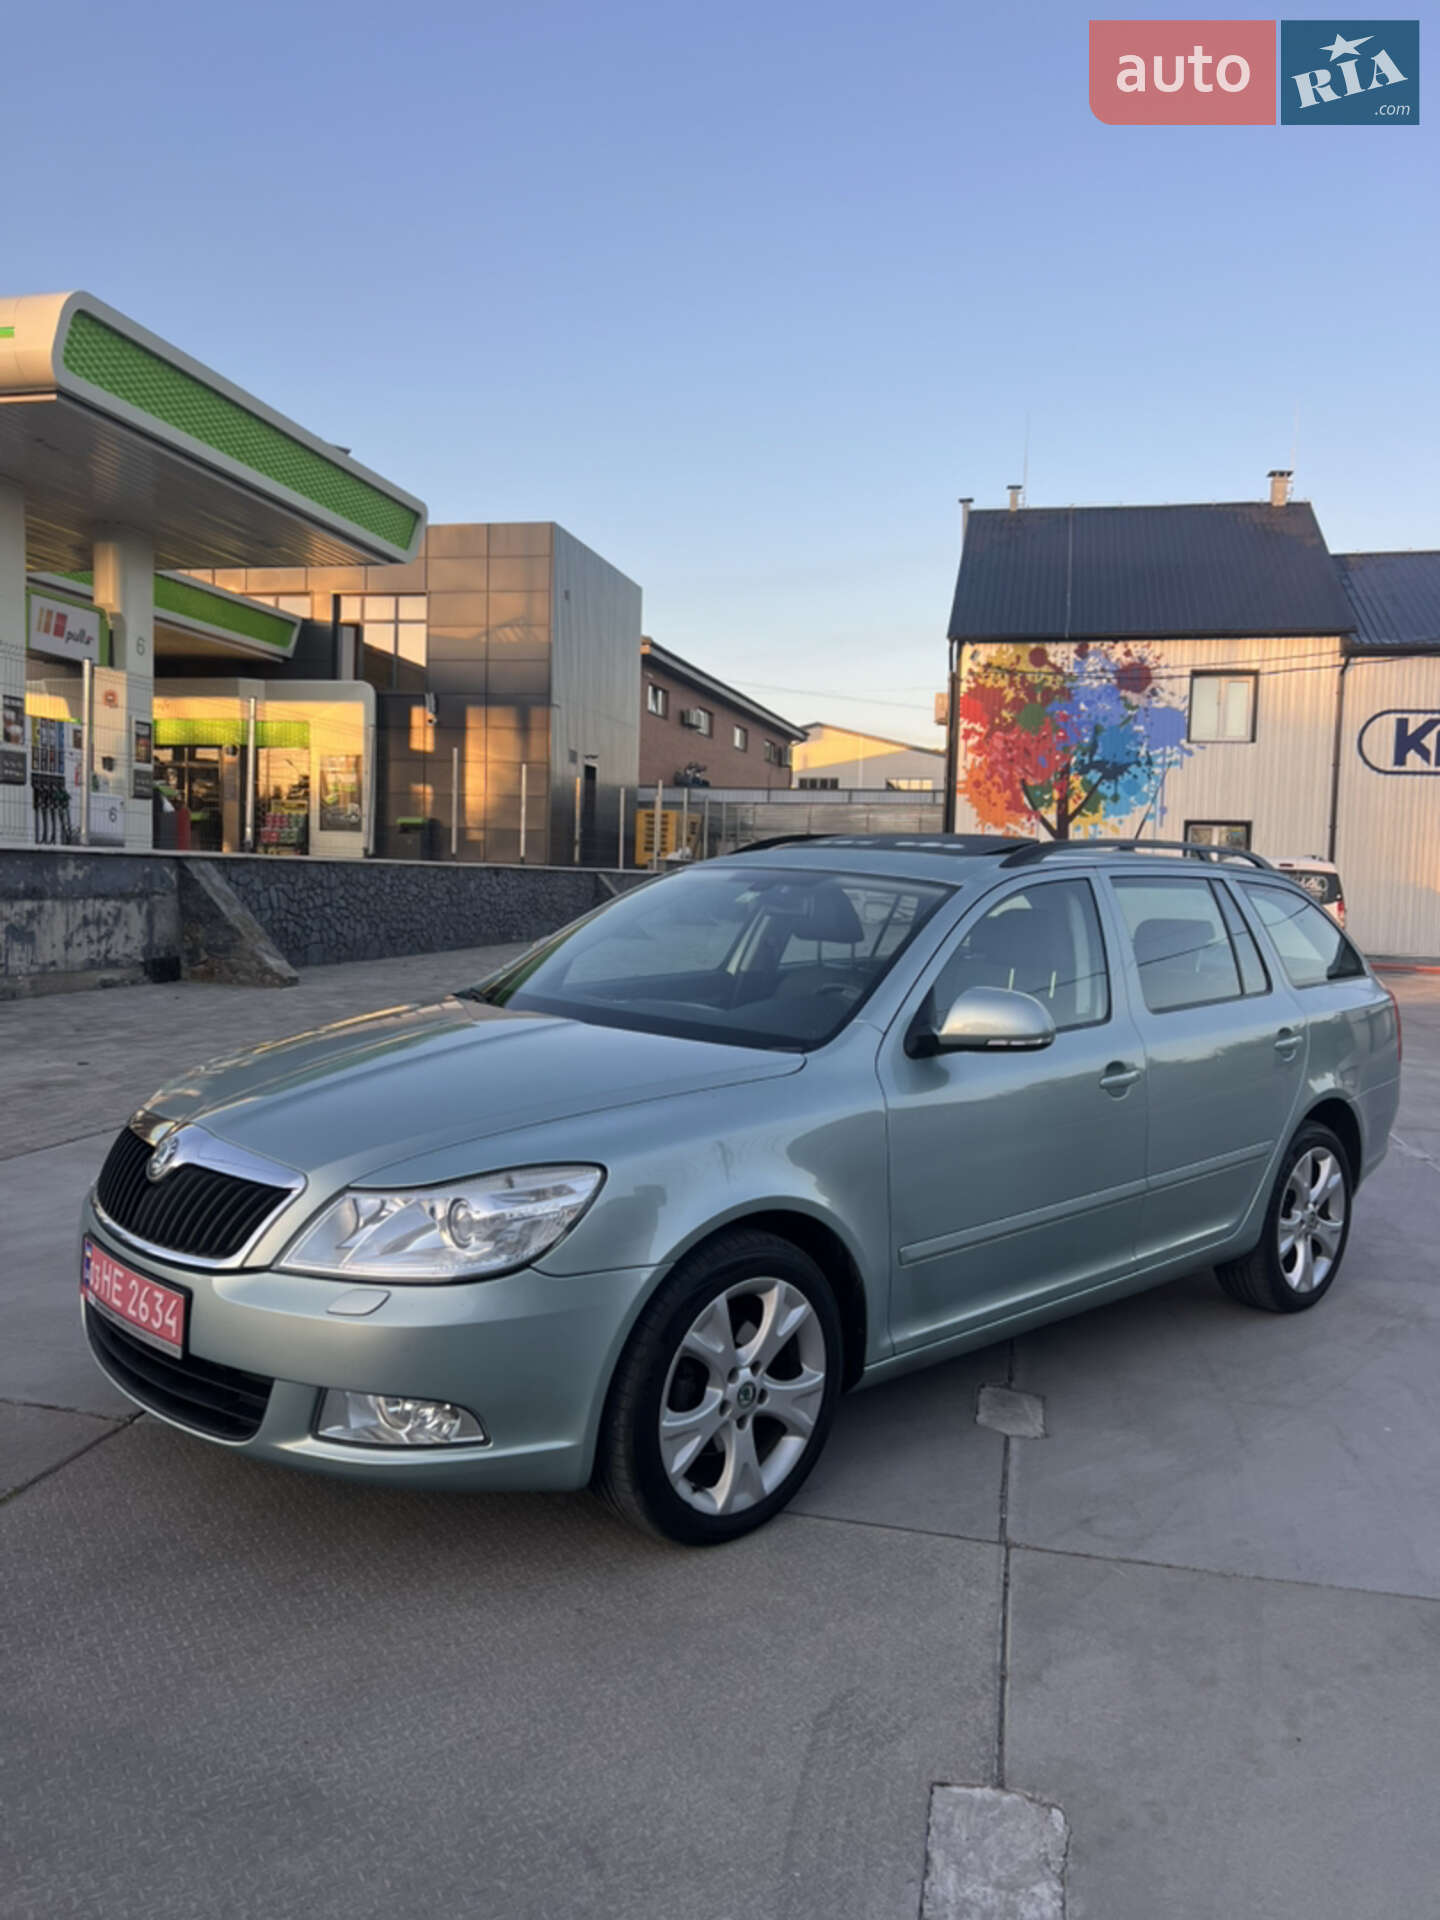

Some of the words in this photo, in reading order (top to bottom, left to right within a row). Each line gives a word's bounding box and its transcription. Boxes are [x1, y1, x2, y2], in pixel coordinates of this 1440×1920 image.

[135, 635, 147, 657] 6
[1394, 718, 1440, 767] K
[109, 806, 118, 823] 6
[127, 1279, 178, 1338] 2634
